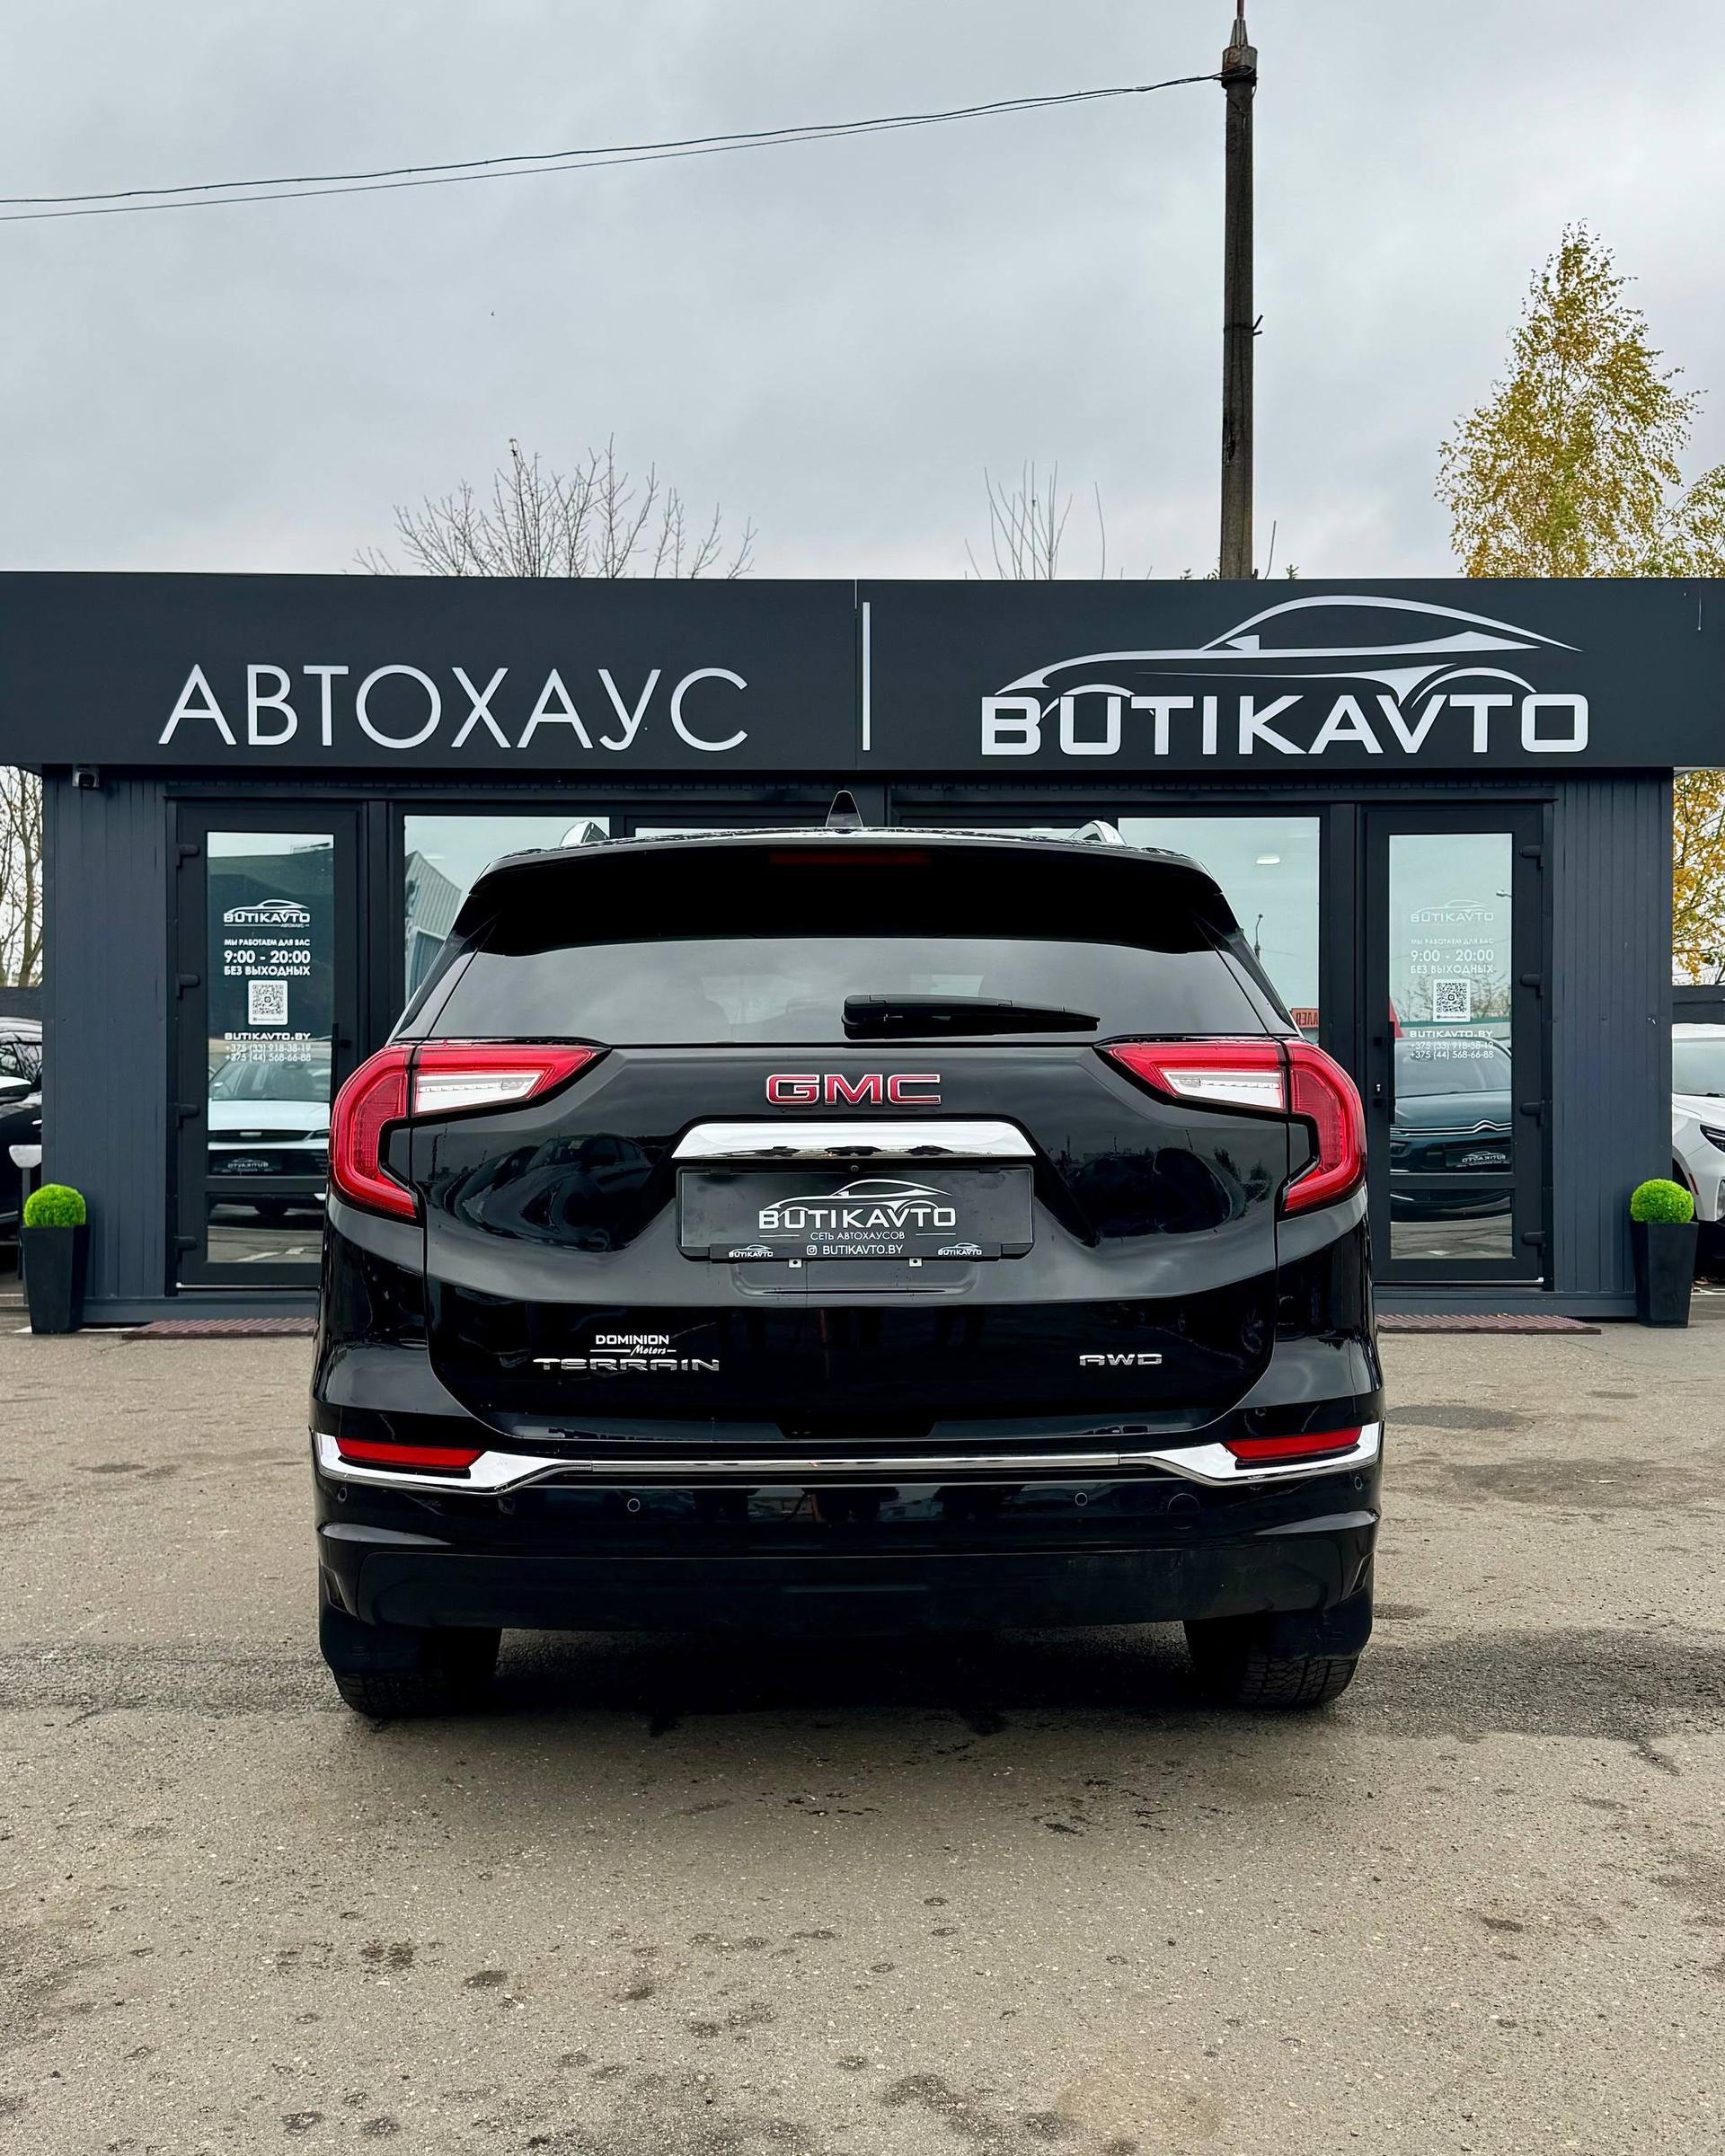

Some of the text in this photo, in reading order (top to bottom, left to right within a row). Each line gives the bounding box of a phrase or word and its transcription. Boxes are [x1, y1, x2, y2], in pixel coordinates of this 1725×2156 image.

[159, 664, 748, 752] АВТОХАУС
[981, 694, 1588, 756] BUTIKAVTO
[224, 913, 310, 923] BUTIKAVTO
[1411, 912, 1493, 923] BUTIKAVTO
[224, 950, 256, 963] 9:00
[270, 950, 311, 963] 20:00
[1411, 950, 1440, 962] 9:00
[1455, 950, 1494, 962] 20:00
[224, 966, 311, 976] БЕЗ ВЫХОДНЫХ
[1411, 965, 1493, 974] БЕЗ ВЫХОДНЫХ
[225, 1032, 311, 1040] BUTIKAVTO.BY
[226, 1044, 312, 1054] +375 (33) 918-38-19
[1410, 1041, 1431, 1049] +375
[1433, 1041, 1450, 1051] (33)
[226, 1053, 312, 1063] +375 (44) 568-66-88
[1410, 1050, 1494, 1060] +375 (44) 568-66-88
[766, 1074, 942, 1104] GMC
[759, 1207, 956, 1229] BUTIKAVTO
[810, 1231, 906, 1241] СЕТЬ АВТОХАУСОВ
[729, 1250, 774, 1258] BUTIKAVTO
[822, 1244, 904, 1255] BUTIKAVTO.BY
[596, 1335, 669, 1345] DOMINION
[630, 1345, 667, 1356] Motors
[533, 1358, 720, 1371] TERRAIN
[1079, 1354, 1163, 1366] AWD
